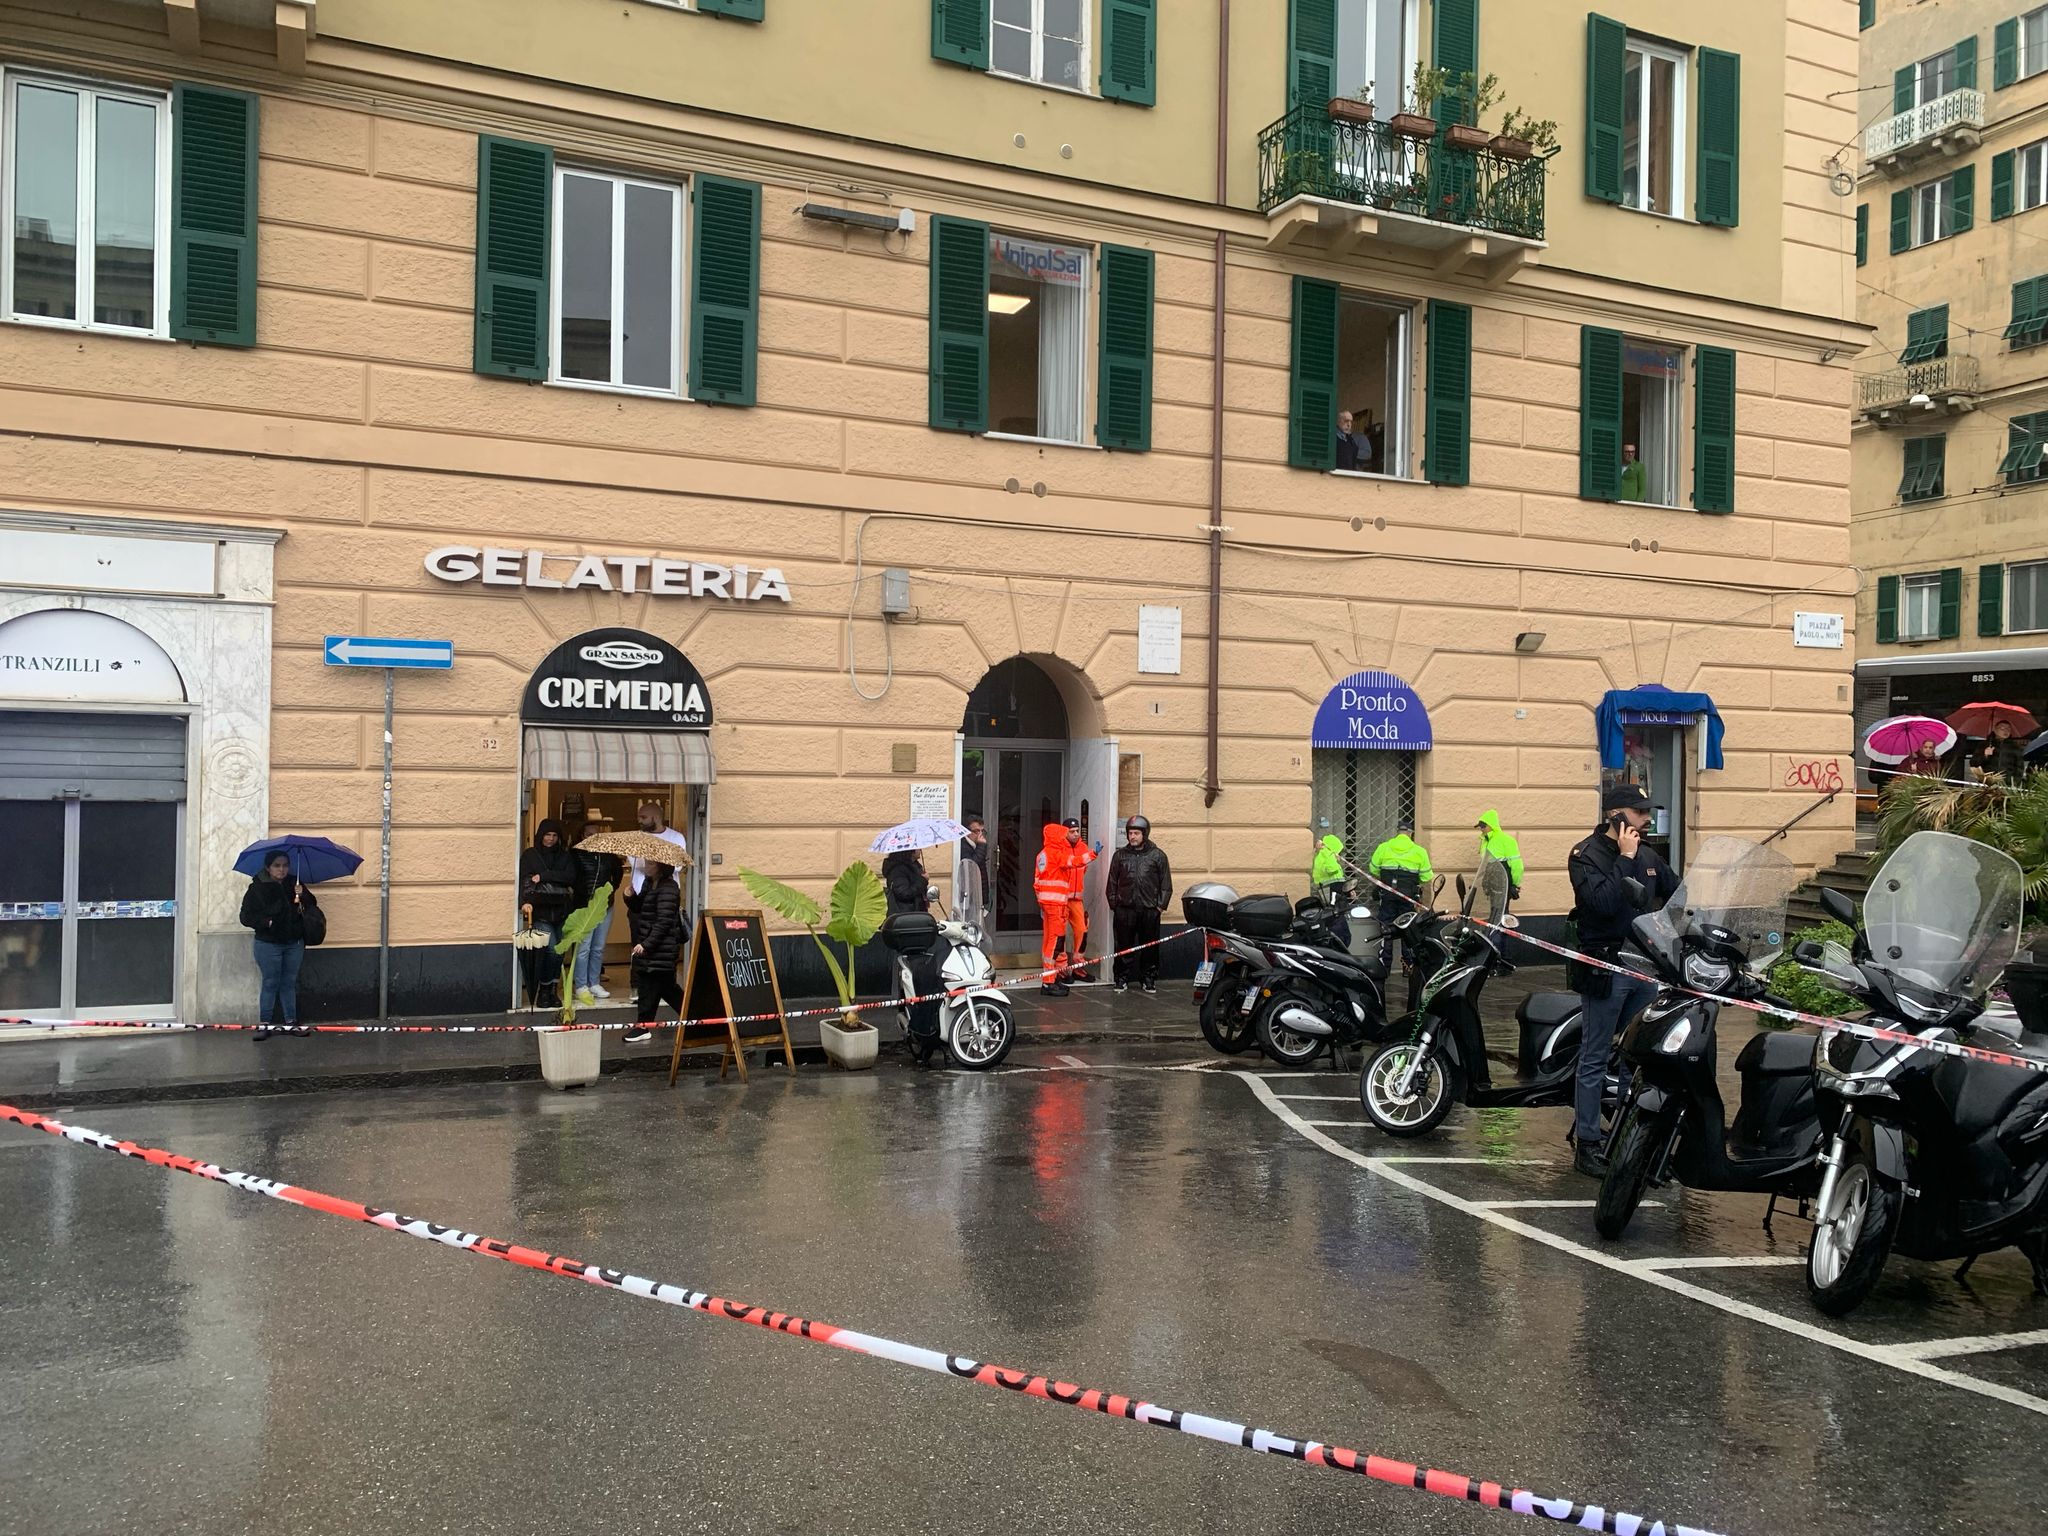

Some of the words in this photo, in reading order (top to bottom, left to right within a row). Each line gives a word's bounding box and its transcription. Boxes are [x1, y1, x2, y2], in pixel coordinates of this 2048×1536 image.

[994, 239, 1082, 274] UnipolSai
[423, 545, 792, 603] GELATERIA
[1799, 630, 1819, 639] PAOLO
[1808, 621, 1831, 630] PIAZZA
[0, 654, 100, 673] TRANZILLI
[585, 647, 618, 660] GRAN
[620, 649, 660, 662] SASSO
[1971, 673, 1995, 683] 8853
[537, 676, 706, 713] CREMERIA
[1340, 688, 1407, 713] Pronto
[671, 712, 704, 723] OASI
[1347, 716, 1399, 741] Moda
[725, 937, 753, 960] OGGI
[725, 958, 772, 988] GRANITE
